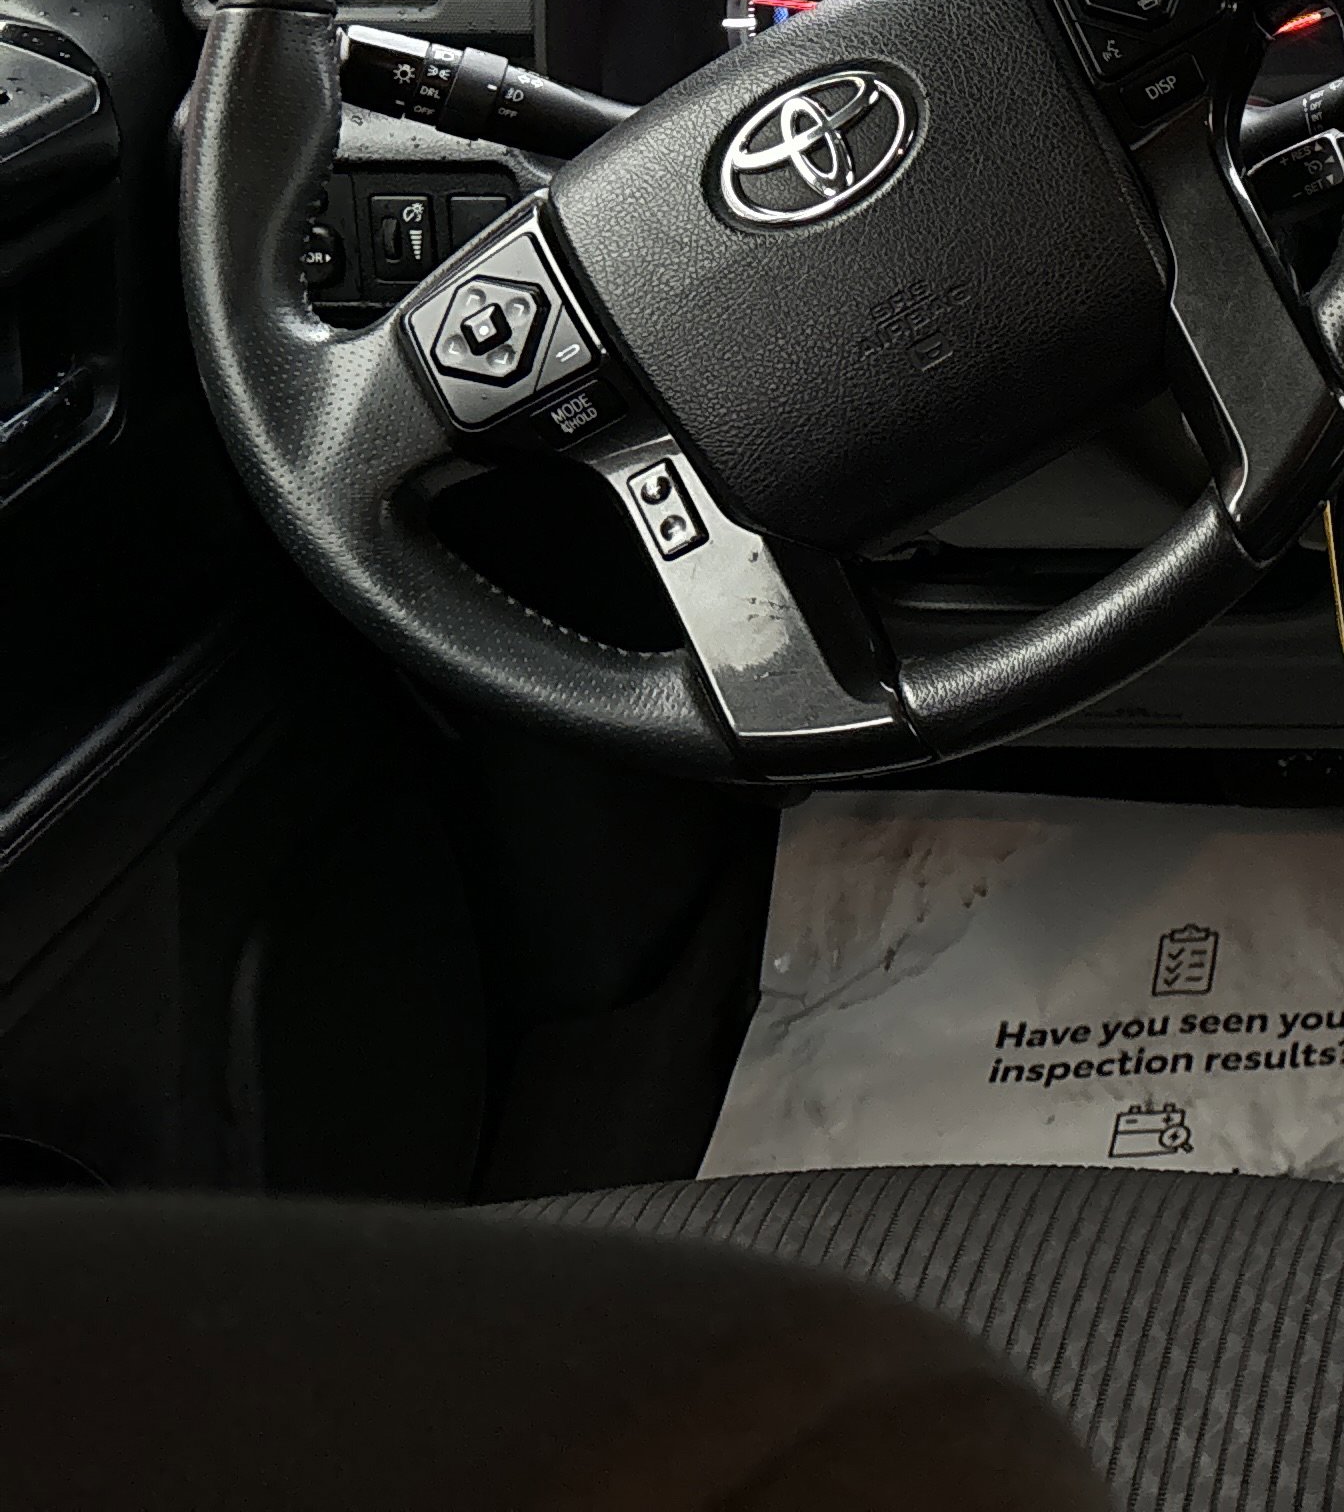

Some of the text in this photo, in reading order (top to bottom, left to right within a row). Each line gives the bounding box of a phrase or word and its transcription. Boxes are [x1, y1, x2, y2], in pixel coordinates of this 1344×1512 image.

[419, 85, 441, 99] DRL
[1145, 75, 1177, 100] DISP
[413, 104, 436, 115] OFF
[498, 106, 519, 118] OFF
[1291, 146, 1312, 162] RES
[550, 393, 593, 424] MODE
[568, 406, 598, 433] HOLD
[995, 1020, 1091, 1049] Have
[1097, 1011, 1170, 1047] you
[1178, 1005, 1268, 1035] seen
[988, 1046, 1193, 1088] inspection
